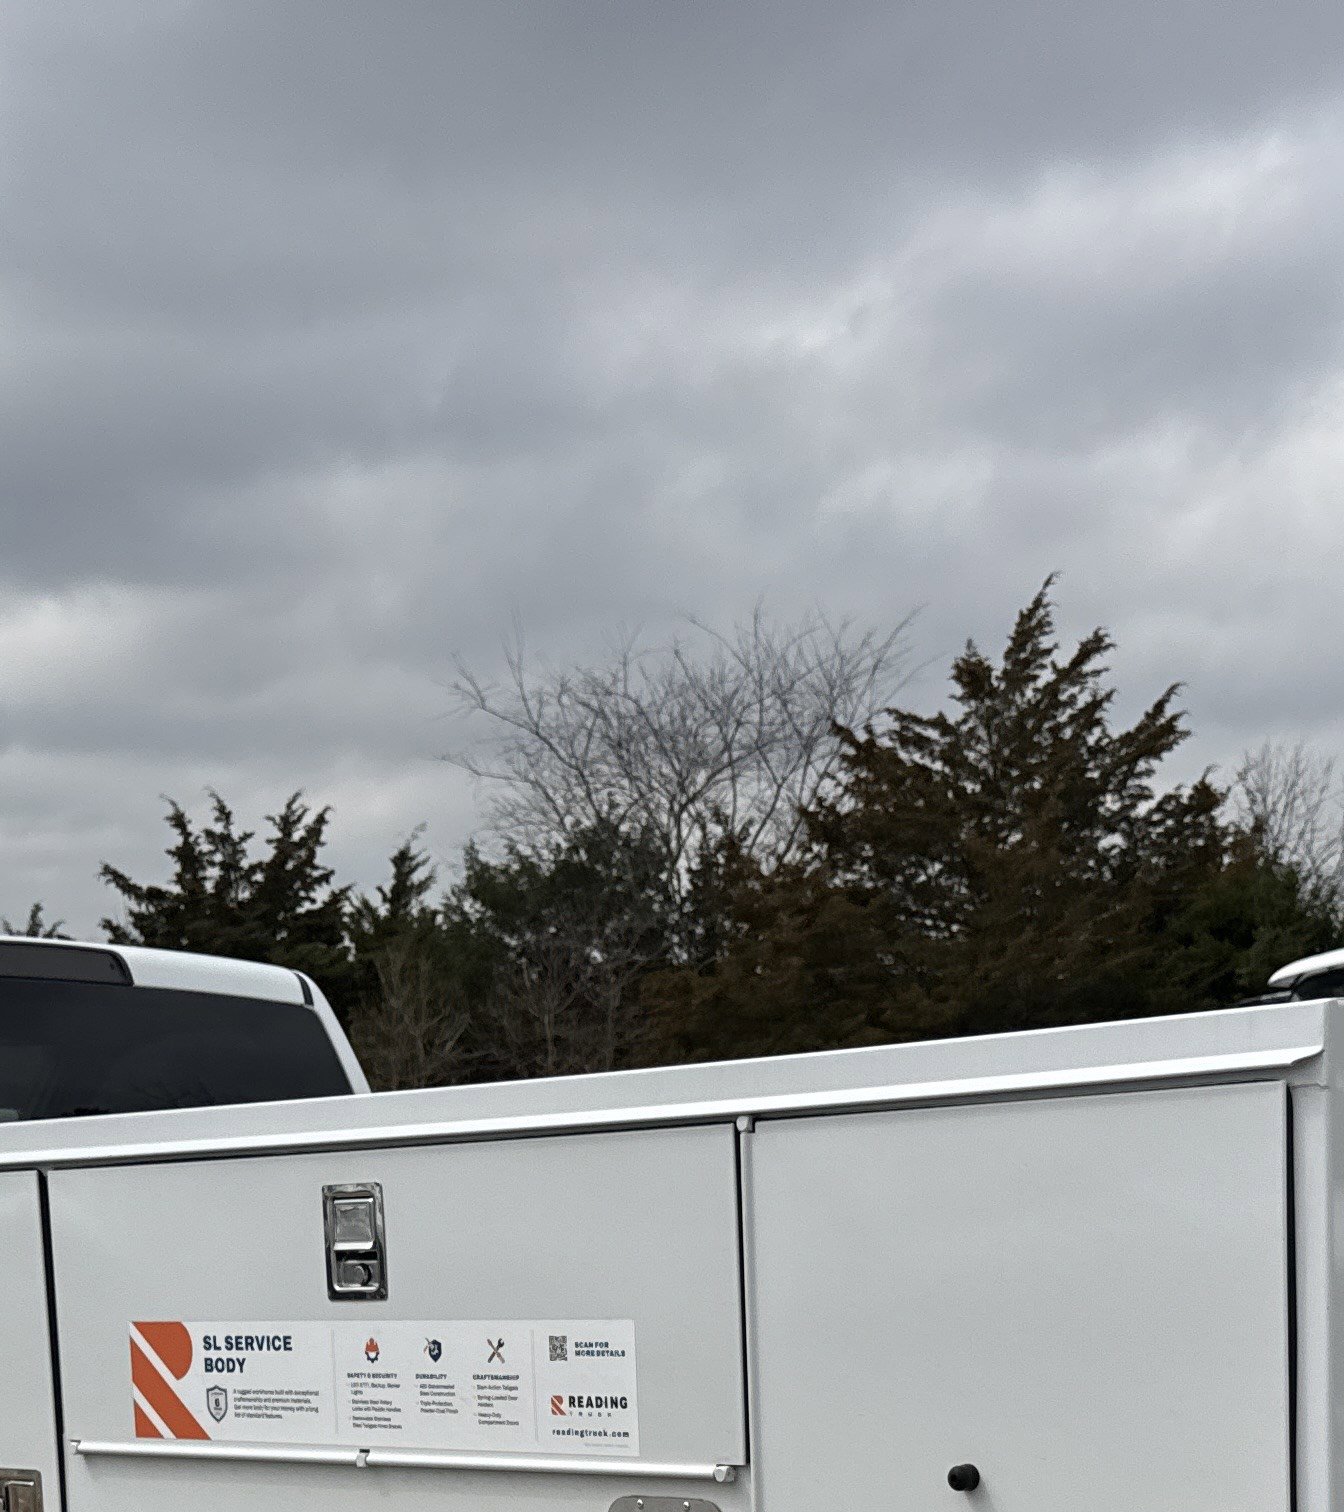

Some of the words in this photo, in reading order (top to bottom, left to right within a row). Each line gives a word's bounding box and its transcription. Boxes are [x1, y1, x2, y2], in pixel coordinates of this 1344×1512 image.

[202, 1335, 222, 1352] SL
[224, 1334, 293, 1352] SERVICE
[594, 1341, 609, 1349] FOR
[203, 1357, 247, 1374] BODY
[568, 1395, 628, 1410] READING
